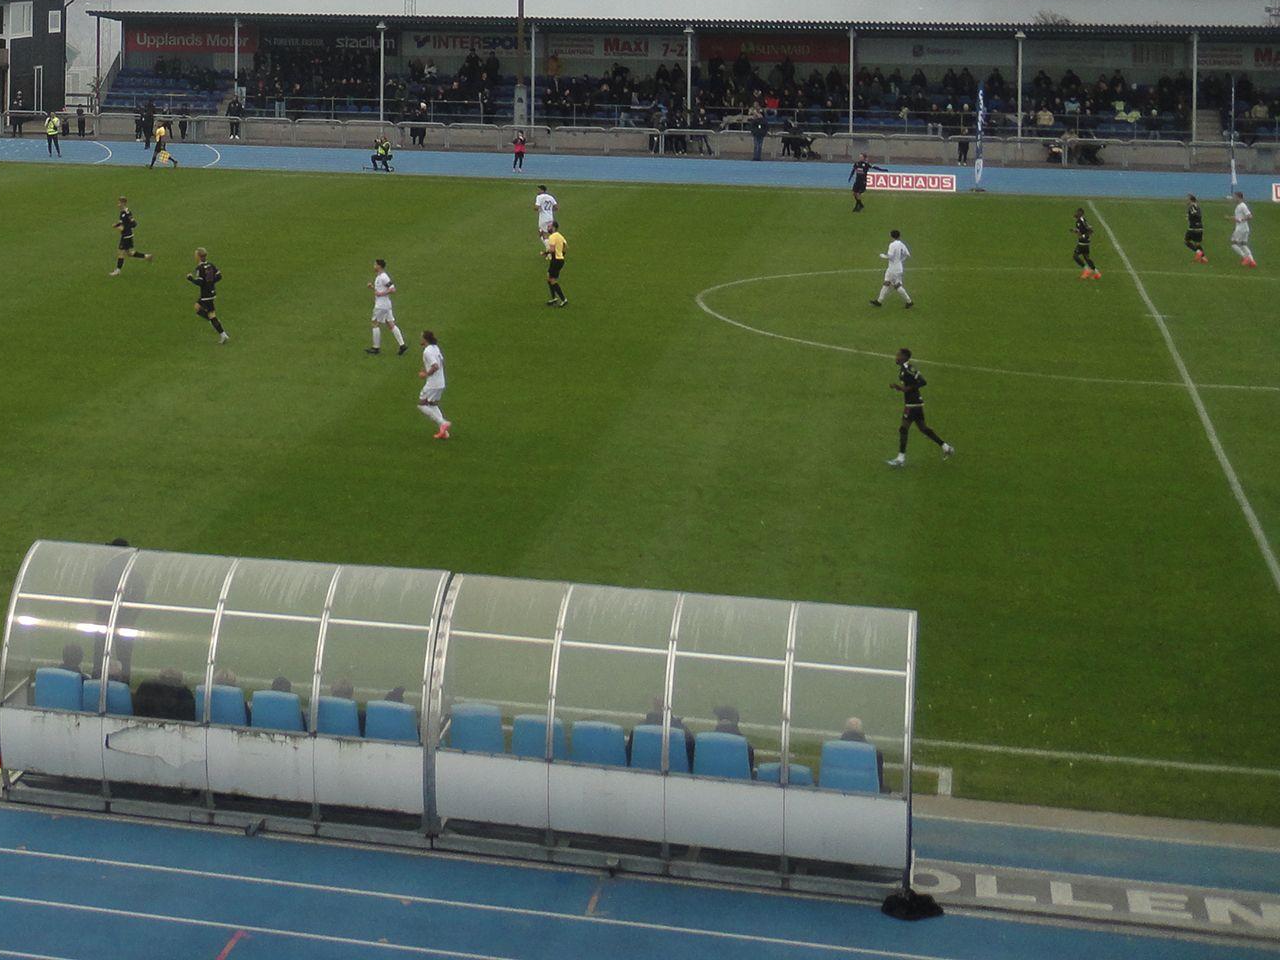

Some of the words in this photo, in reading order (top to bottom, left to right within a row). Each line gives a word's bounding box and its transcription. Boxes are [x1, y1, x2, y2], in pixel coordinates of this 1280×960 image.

[136, 33, 202, 48] Upplands
[336, 35, 395, 49] stadium
[866, 175, 952, 188] BAUHAUS
